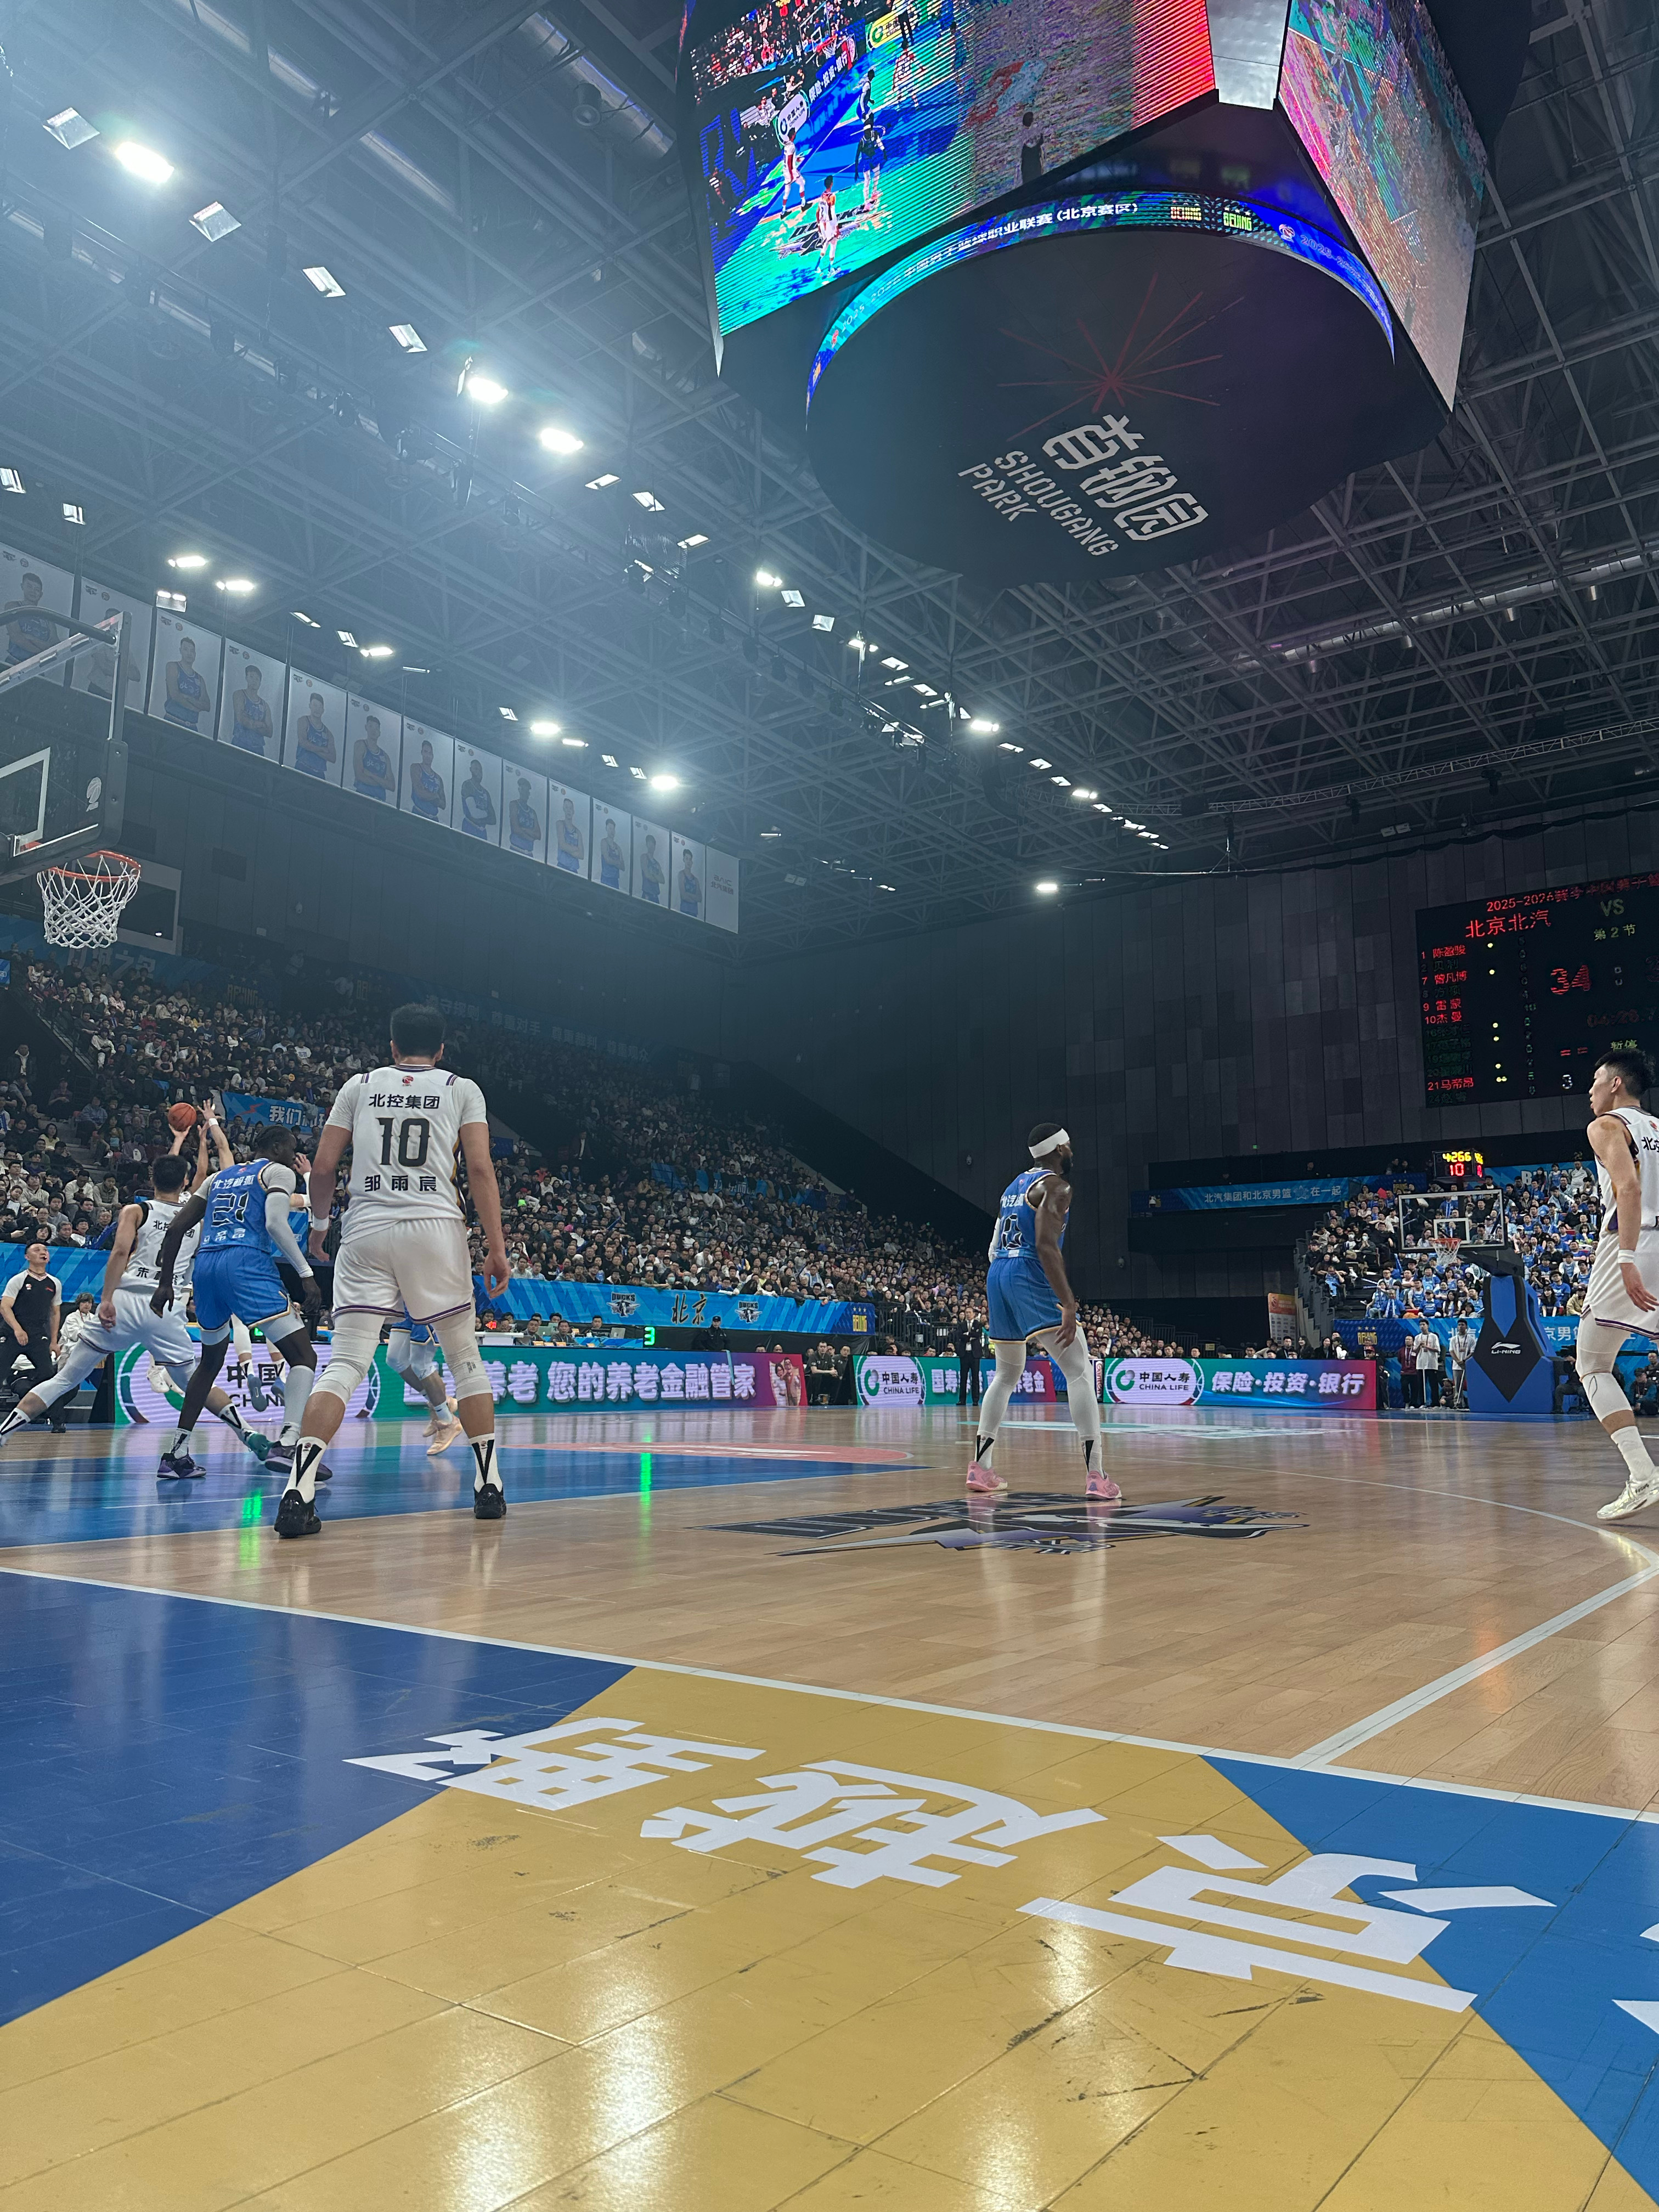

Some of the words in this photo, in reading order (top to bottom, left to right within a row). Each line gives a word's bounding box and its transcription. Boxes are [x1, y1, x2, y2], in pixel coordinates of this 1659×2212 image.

[1223, 212, 1252, 231] BEIJING
[1042, 414, 1209, 541] 首钢园
[957, 463, 1039, 522] PARK
[994, 450, 1120, 557] SHOUGANG
[1600, 898, 1626, 917] VS
[1465, 909, 1552, 939] 北京北汽
[1421, 951, 1426, 960] 1
[1421, 977, 1427, 986] 7
[1550, 964, 1591, 995] 34
[1423, 1003, 1429, 1012] 9
[1425, 1015, 1436, 1025] 10
[1427, 1082, 1440, 1091] 21
[1440, 1077, 1475, 1091] 马帝昂
[1562, 1074, 1573, 1089] 3
[368, 1093, 440, 1109] 北控集团
[375, 1118, 431, 1167] 10
[1449, 1163, 1464, 1176] 10
[212, 1174, 256, 1191] 北汽极狐
[364, 1174, 437, 1192] 邹雨宸
[1204, 1187, 1292, 1204] 北汽集团和北京男篮
[1310, 1185, 1341, 1197] 在一起
[211, 1191, 249, 1227] 21
[612, 1292, 636, 1302] DUCKS
[739, 1301, 759, 1310] DUCKS
[671, 1292, 708, 1326] 北京
[644, 1326, 656, 1346] 3
[547, 1361, 756, 1403] 您的养老金融管家
[882, 1372, 919, 1385] 中国人寿
[1139, 1372, 1190, 1383] 中国人寿
[883, 1387, 905, 1395] CHINA
[906, 1386, 919, 1395] LIFE
[343, 1718, 1659, 2033] 京越野
